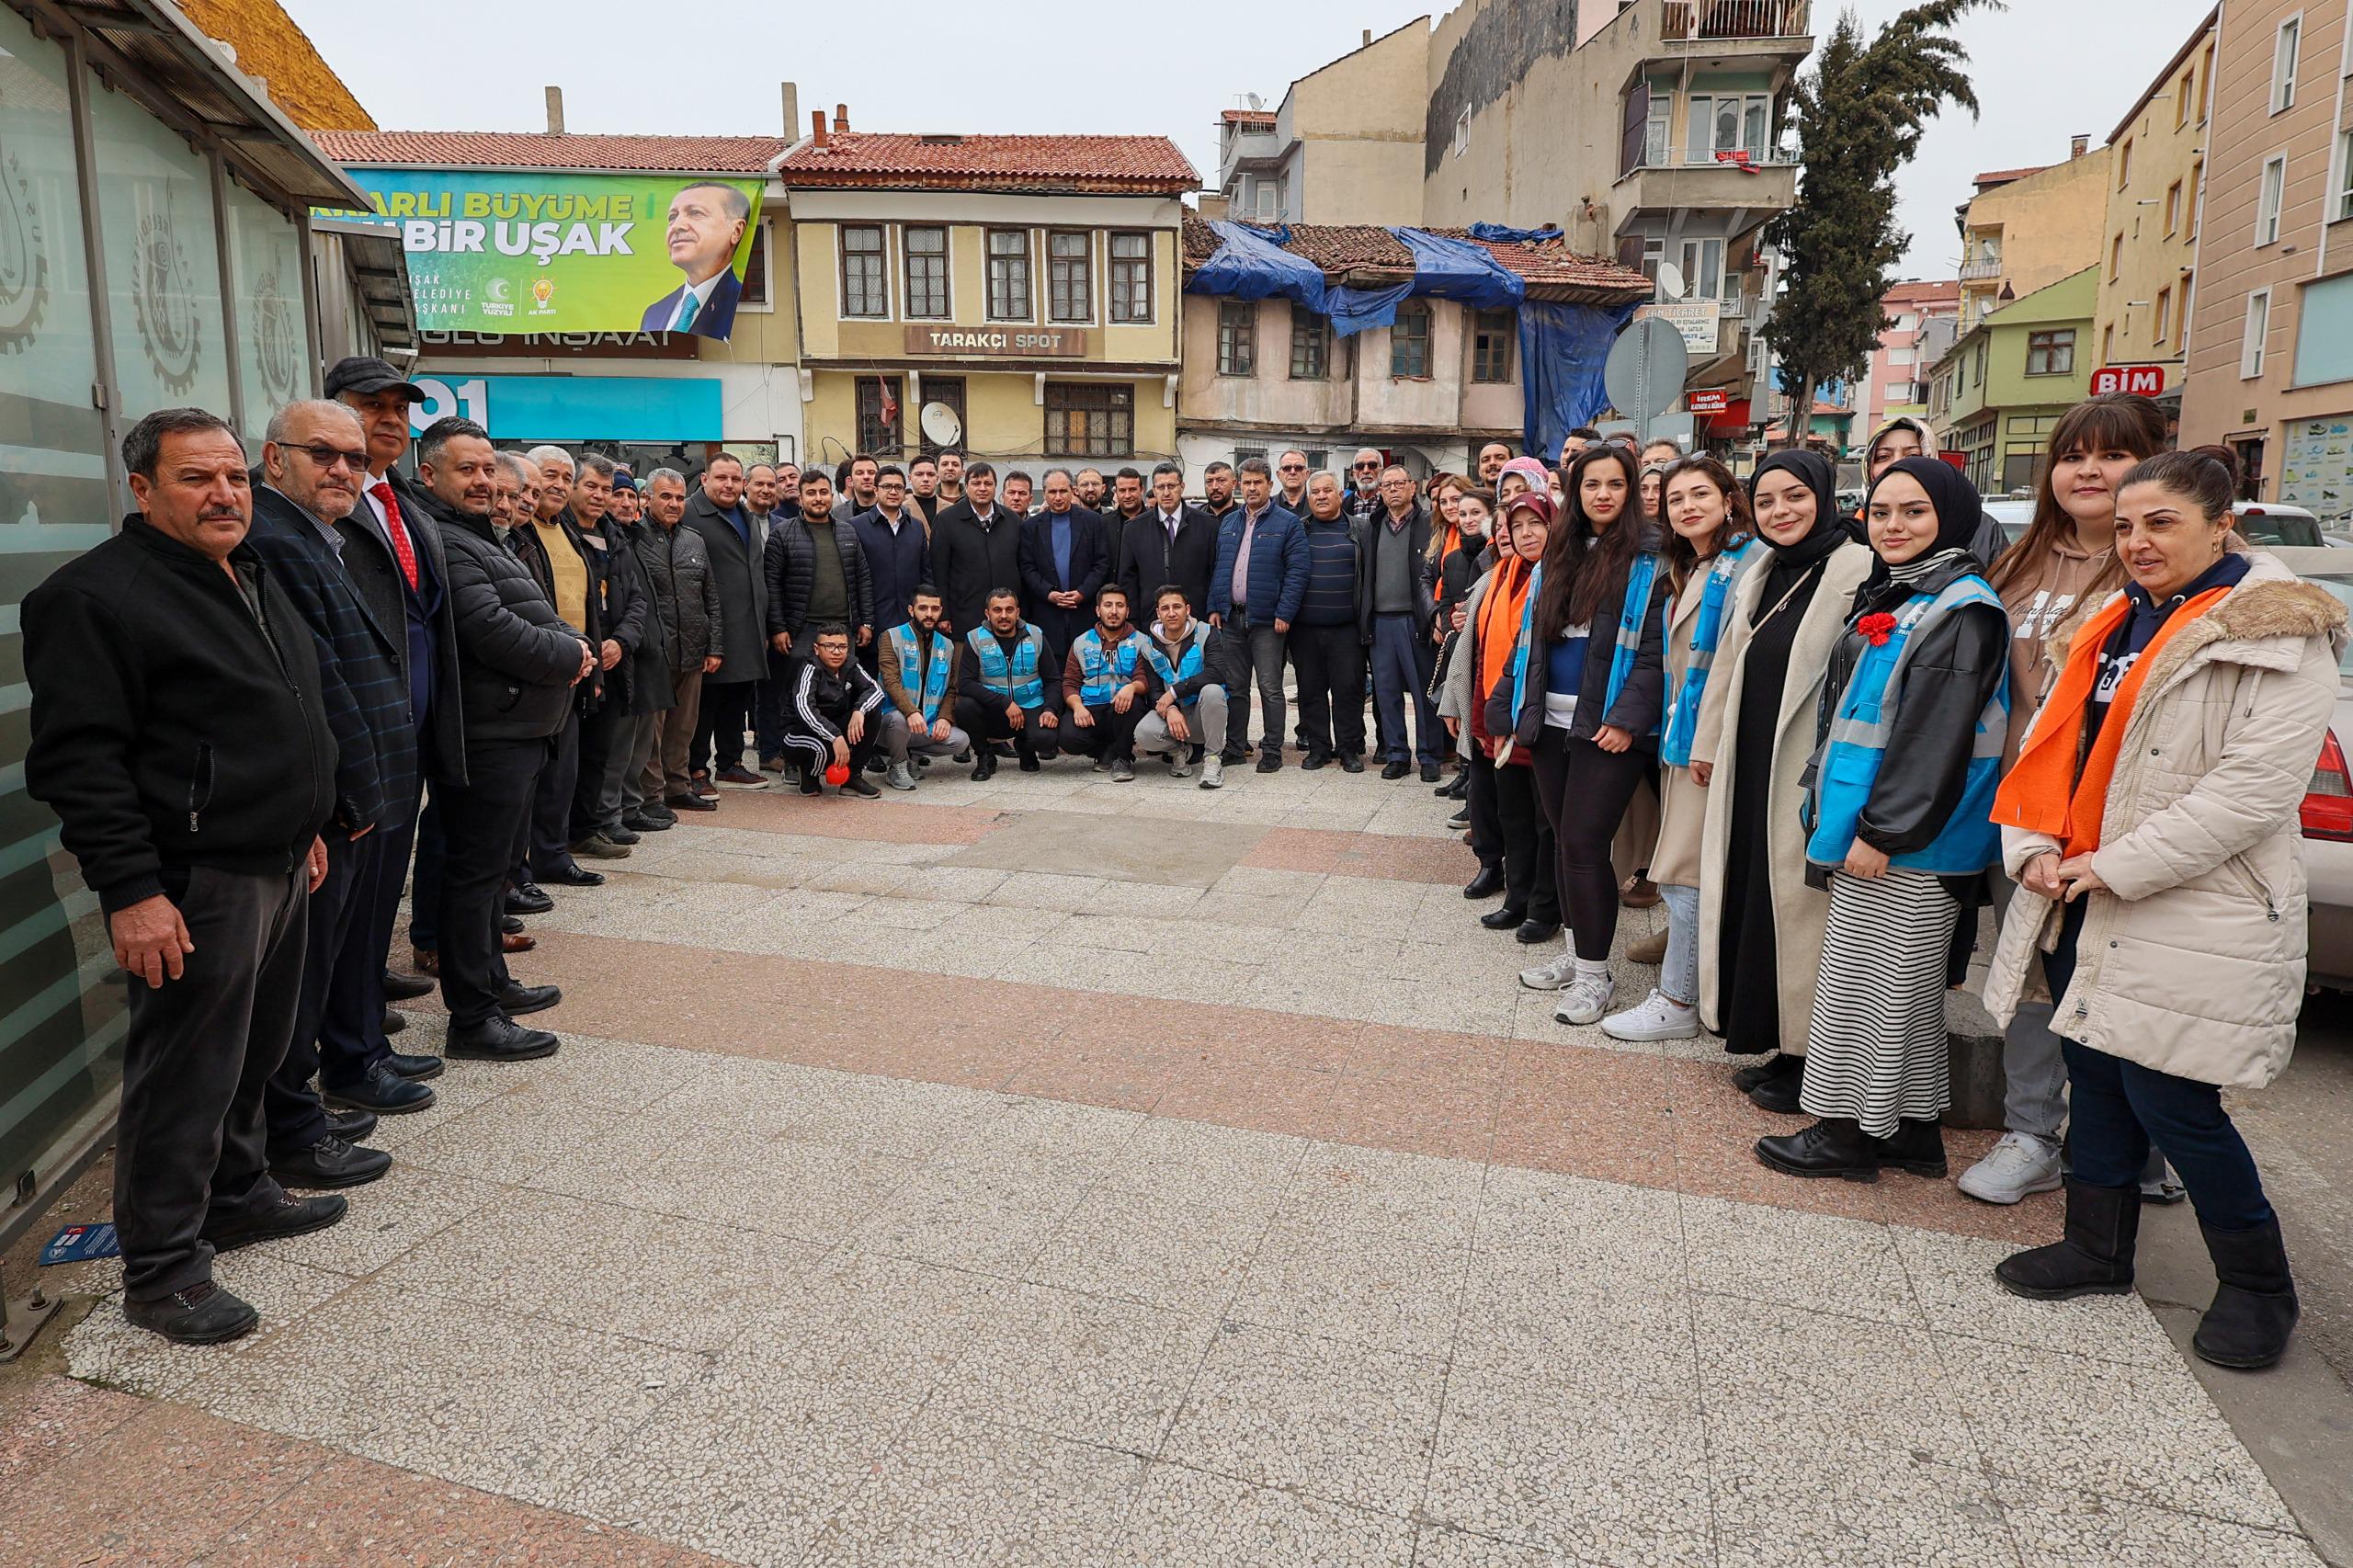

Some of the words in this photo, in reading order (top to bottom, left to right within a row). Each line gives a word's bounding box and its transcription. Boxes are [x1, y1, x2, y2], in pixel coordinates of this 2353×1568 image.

[464, 193, 633, 220] BÜYÜME
[404, 221, 485, 253] BİR
[494, 222, 635, 267] UŞAK
[930, 333, 1006, 349] TARAKÇI
[1016, 335, 1062, 348] SPOT
[2098, 369, 2156, 392] BİM
